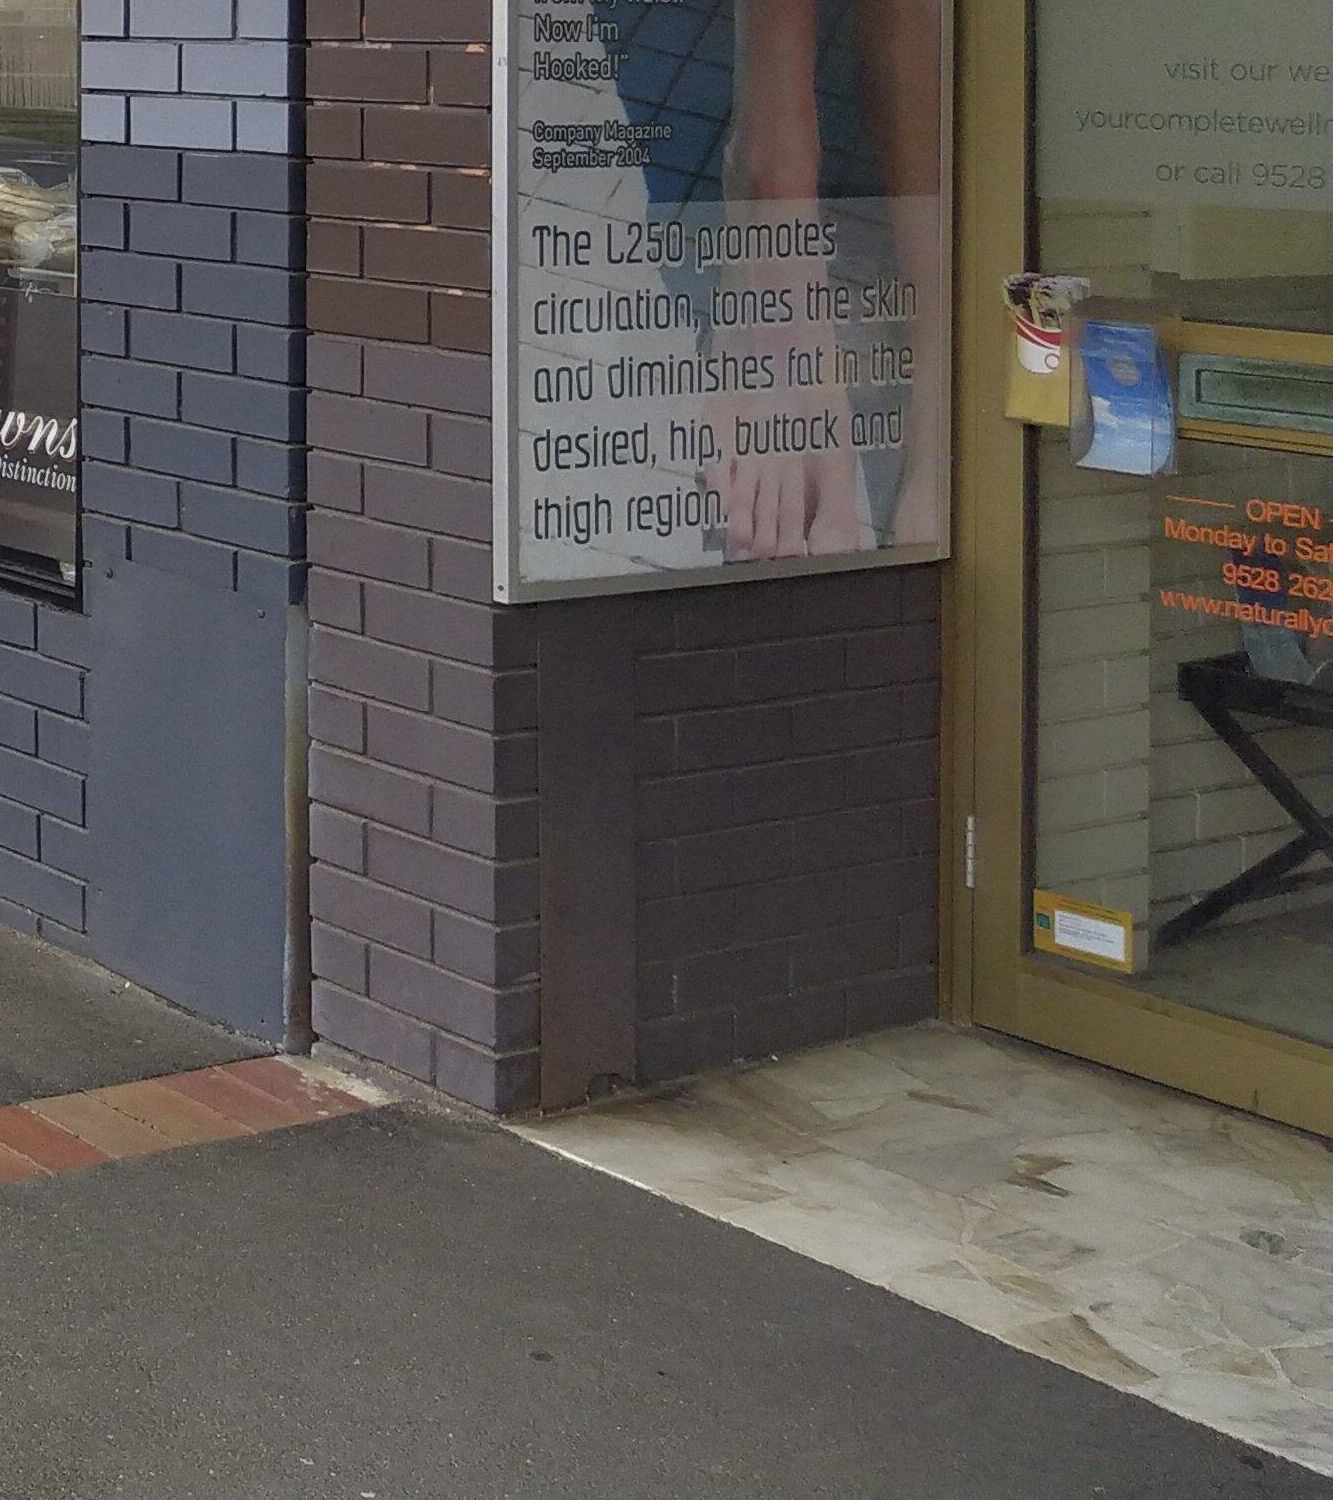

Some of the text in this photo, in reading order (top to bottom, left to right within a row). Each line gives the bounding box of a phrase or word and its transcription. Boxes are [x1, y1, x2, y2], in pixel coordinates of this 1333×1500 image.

[535, 16, 619, 41] Now I'm
[1164, 58, 1219, 81] visit
[1231, 63, 1279, 82] our
[534, 122, 672, 144] Company Magazine
[534, 148, 650, 173] September 2004
[1156, 162, 1325, 190] or call 9528
[532, 219, 836, 269] The L250 promotes
[534, 277, 916, 336] circulation, tones the skin
[535, 342, 914, 403] and diminishes fat in the
[533, 404, 902, 472] desired, hip, buttock and
[534, 485, 729, 544] thigh region.
[1245, 499, 1322, 531] OPEN
[1164, 516, 1257, 556] Monday
[1264, 533, 1289, 556] to
[1222, 562, 1281, 593] 9528
